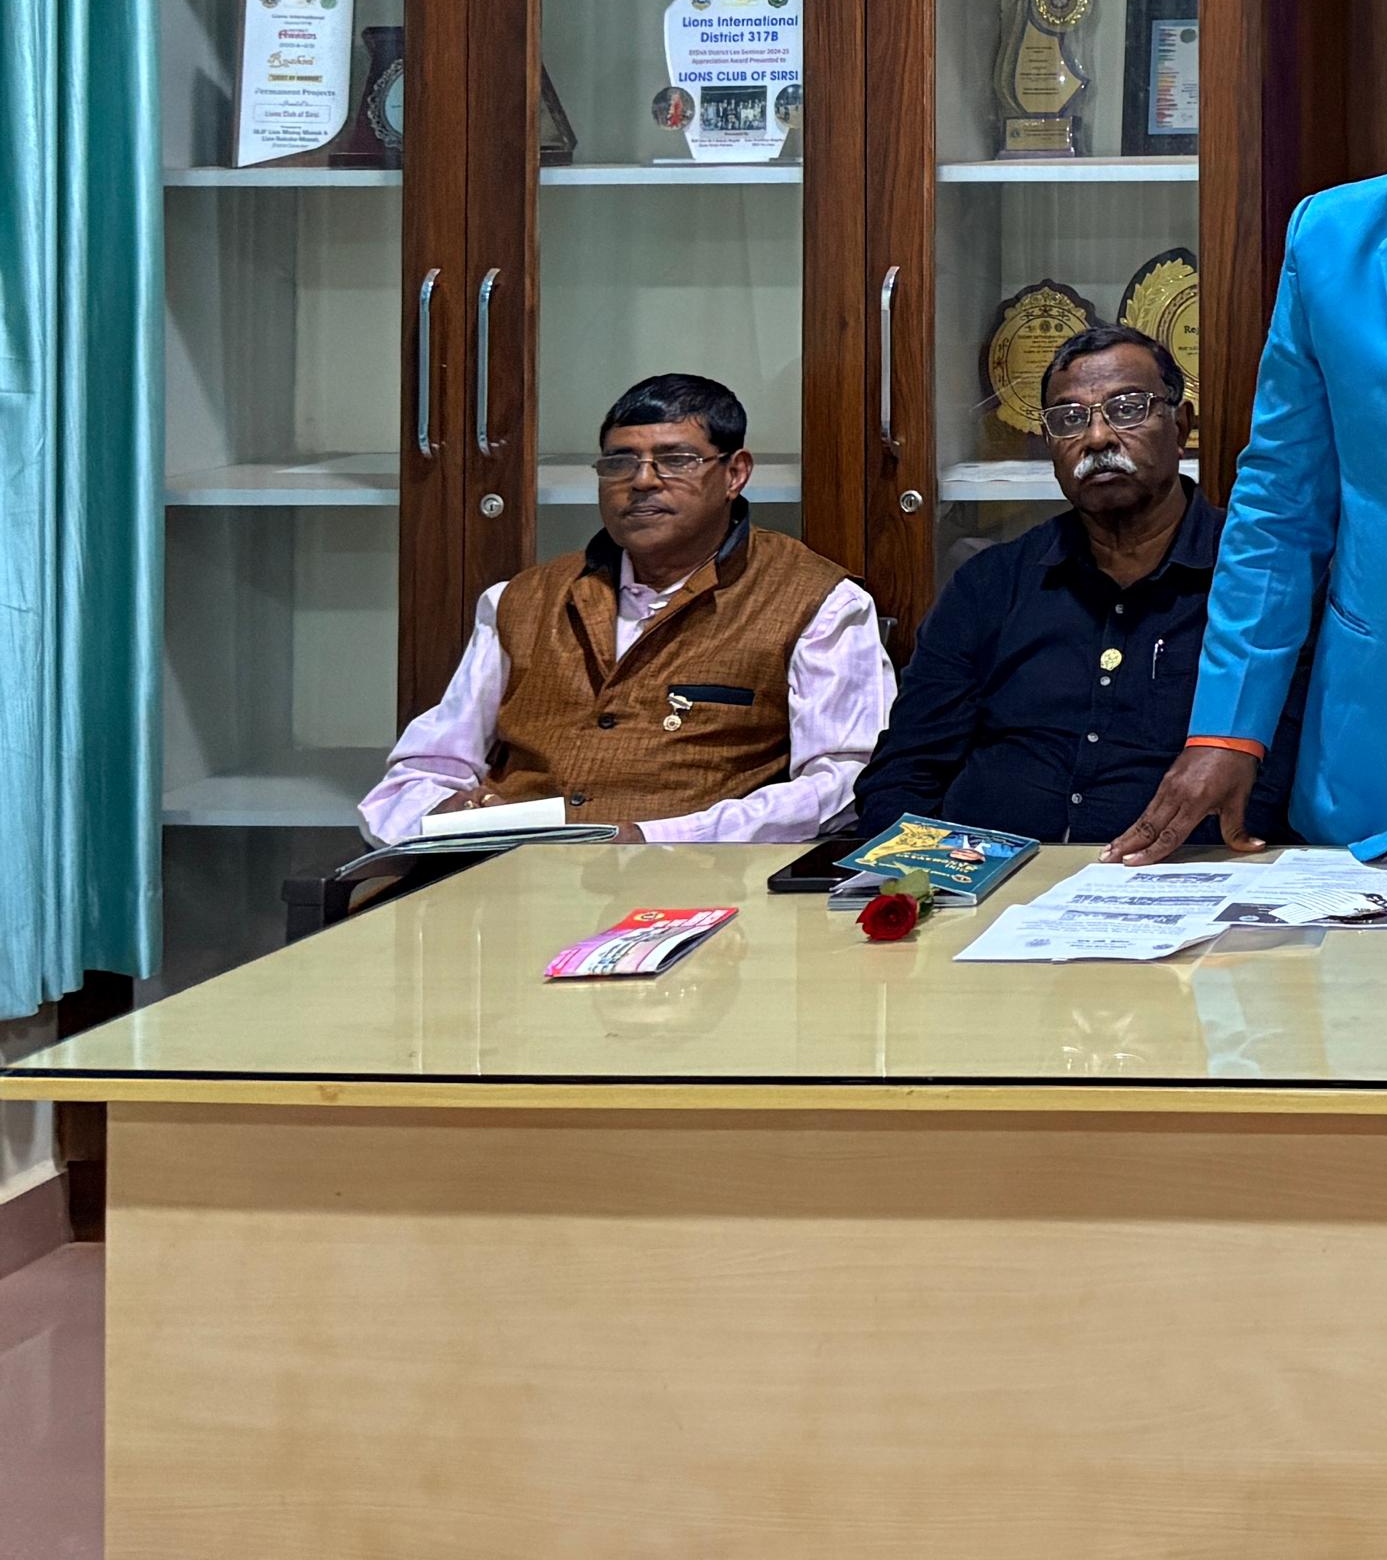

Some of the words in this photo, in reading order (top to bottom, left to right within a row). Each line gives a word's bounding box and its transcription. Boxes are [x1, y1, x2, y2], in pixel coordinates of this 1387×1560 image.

[682, 16, 714, 28] Lions
[717, 15, 799, 27] International
[700, 31, 745, 43] District
[748, 31, 779, 42] 317B
[678, 71, 713, 83] LIONS
[716, 71, 748, 82] CLUB
[751, 71, 767, 82] OF
[770, 71, 799, 82] SIRSI
